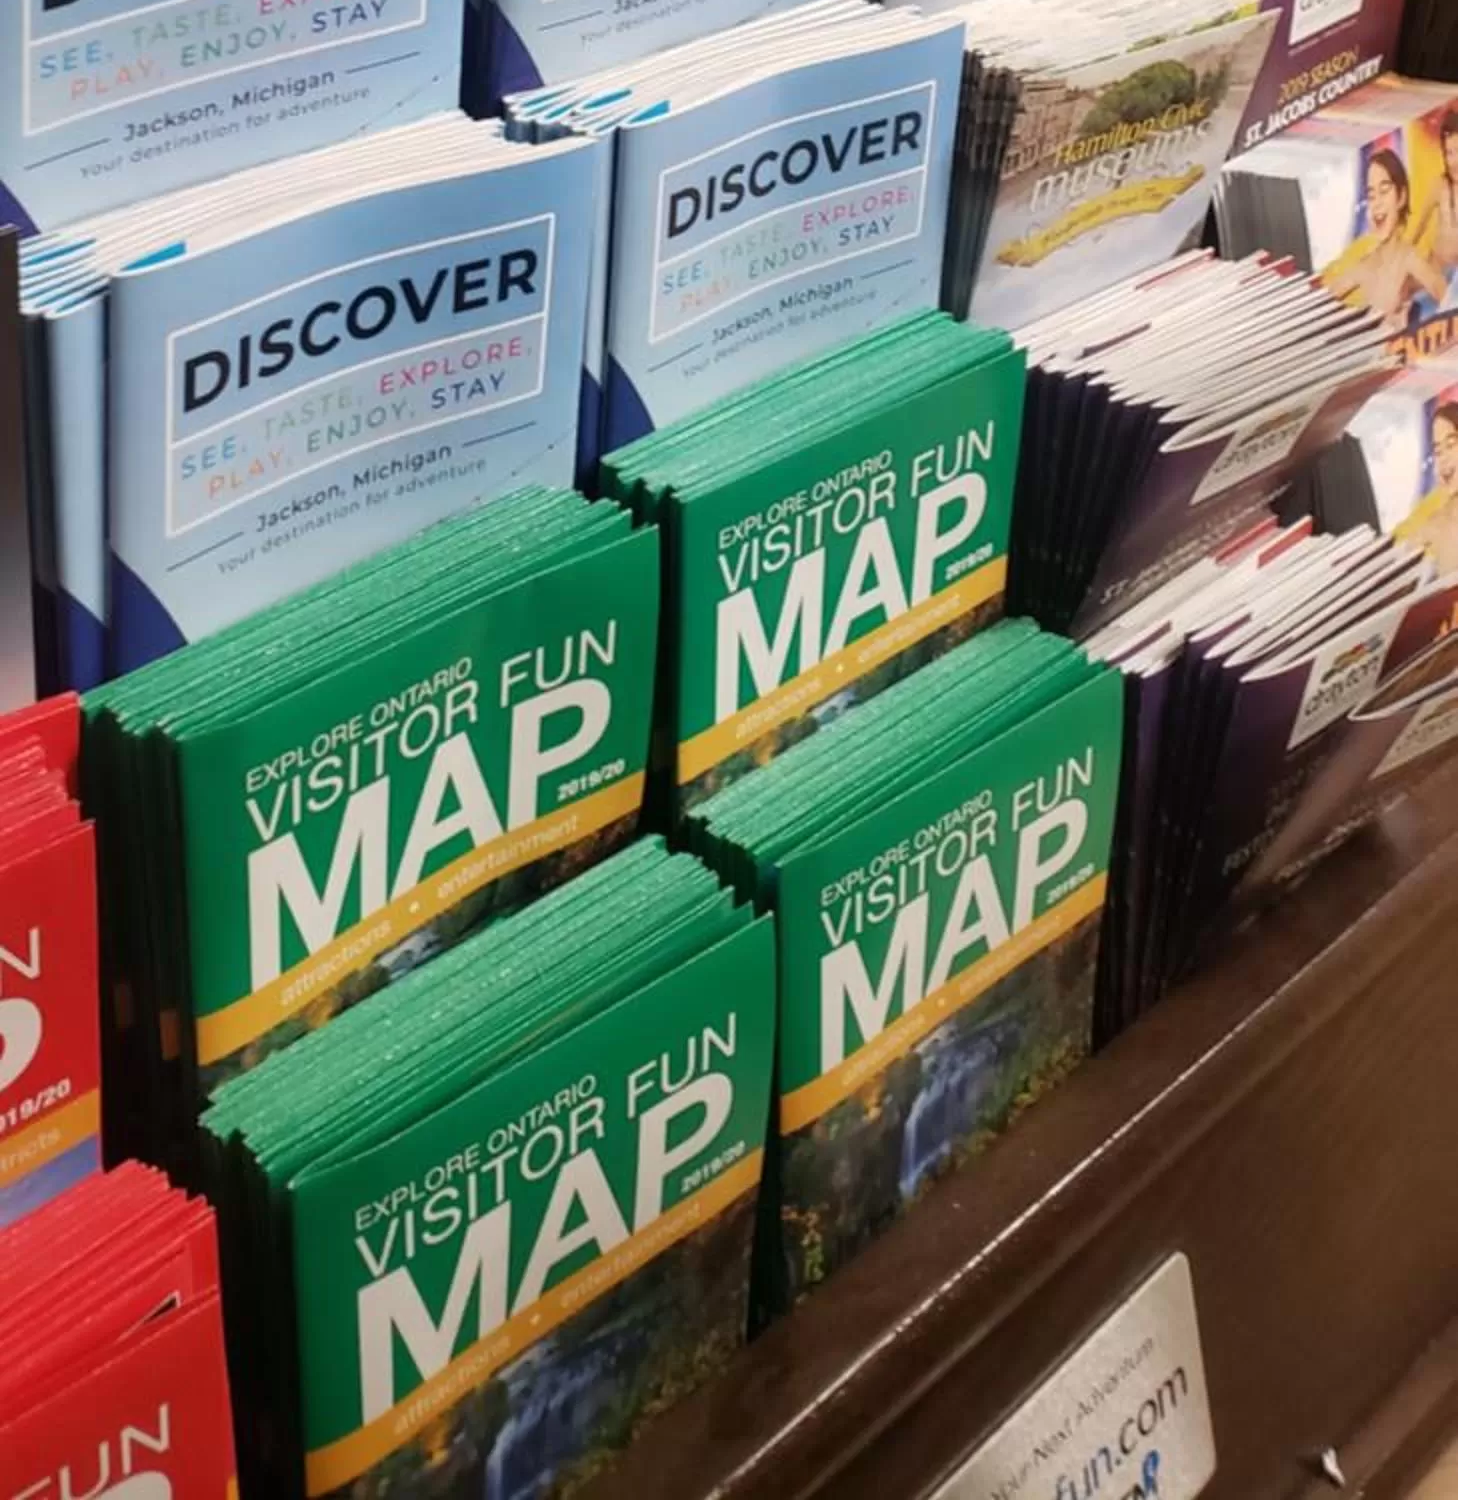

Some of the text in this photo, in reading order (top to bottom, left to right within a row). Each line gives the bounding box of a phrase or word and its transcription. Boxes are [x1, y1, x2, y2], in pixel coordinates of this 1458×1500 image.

[231, 70, 336, 112] Michigan
[1244, 54, 1384, 148] ST. JACOBS COUNTRY
[1311, 45, 1359, 90] SEASON
[129, 119, 240, 164] destination
[245, 109, 272, 129] for
[275, 85, 371, 119] adventure
[1030, 120, 1212, 213] museums
[1054, 118, 1155, 168] Hamilton
[667, 110, 924, 240] DISCOVER
[838, 214, 896, 247] STAY
[182, 248, 539, 413] DISCOVER
[778, 276, 855, 313] Michigan
[431, 370, 508, 410] STAY
[260, 506, 362, 556] destination
[365, 489, 391, 513] for
[393, 457, 489, 500] adventure
[352, 442, 454, 490] Michigan
[717, 420, 995, 594] VISITOR FUN
[718, 450, 893, 550] EXPLORE ONTARIO
[715, 472, 987, 725] MAP
[245, 656, 473, 794] EXPLORE ONTARIO
[245, 619, 617, 843] VISITOR FUN
[735, 677, 822, 739] attractions
[1304, 655, 1381, 718] drayton
[557, 759, 626, 801] 2019/20
[248, 677, 612, 993] MAP
[820, 808, 999, 948] VISITOR
[1012, 745, 1094, 833] FUN
[820, 789, 994, 908] EXPLORE ONTARIO
[280, 814, 579, 1008] attractions entertainment
[820, 798, 1088, 1077] MAP
[355, 1011, 737, 1278] VISITOR FUN
[355, 1074, 597, 1231] EXPLORE ONTARIO
[680, 1140, 747, 1194] 2019/20
[357, 1072, 734, 1426] MAP
[393, 1200, 701, 1435] attractions entertainment
[1076, 1336, 1154, 1426] Adventure
